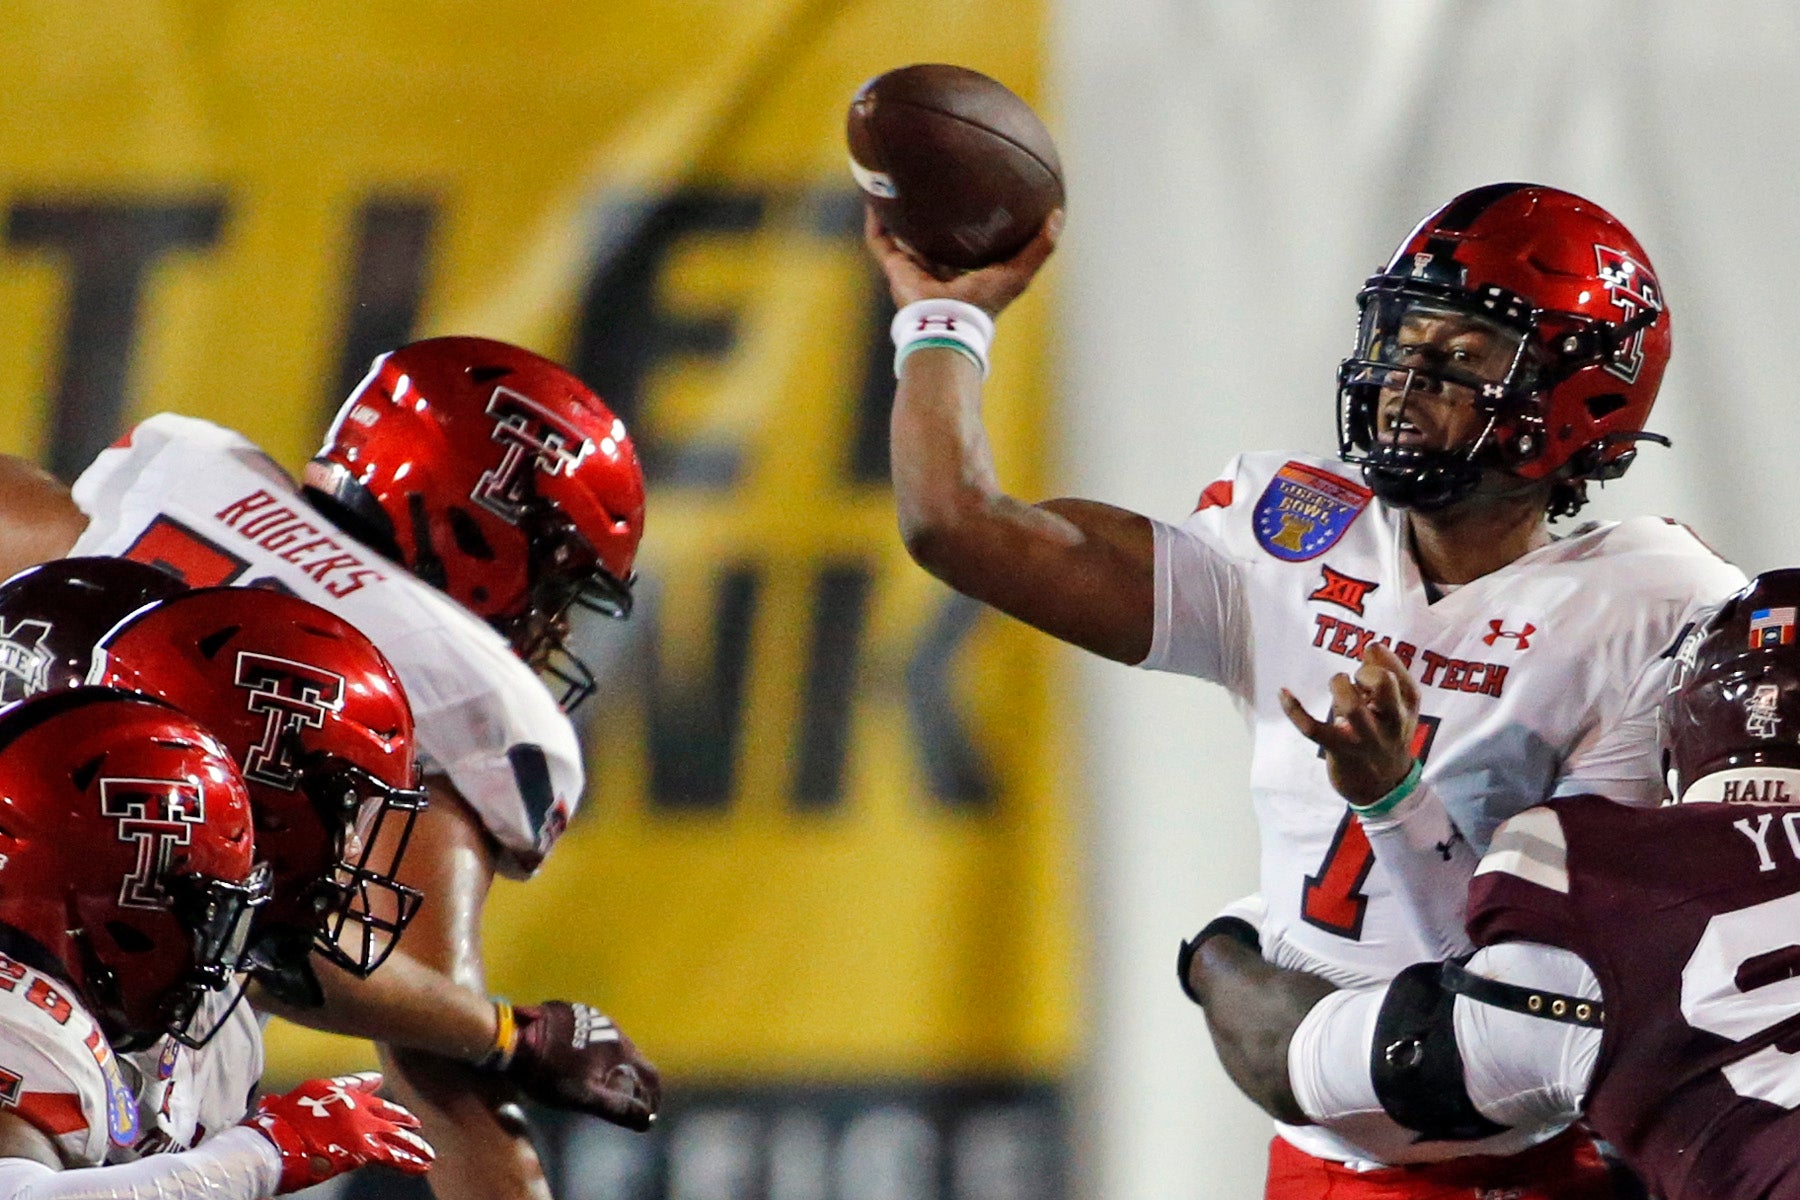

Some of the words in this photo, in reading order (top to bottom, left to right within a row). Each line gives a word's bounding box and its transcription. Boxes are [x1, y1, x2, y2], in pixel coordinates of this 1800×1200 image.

[1279, 496, 1331, 526] BOWL
[214, 489, 388, 599] ROGERS
[1420, 649, 1510, 698] TECH
[1723, 780, 1790, 803] HAIL
